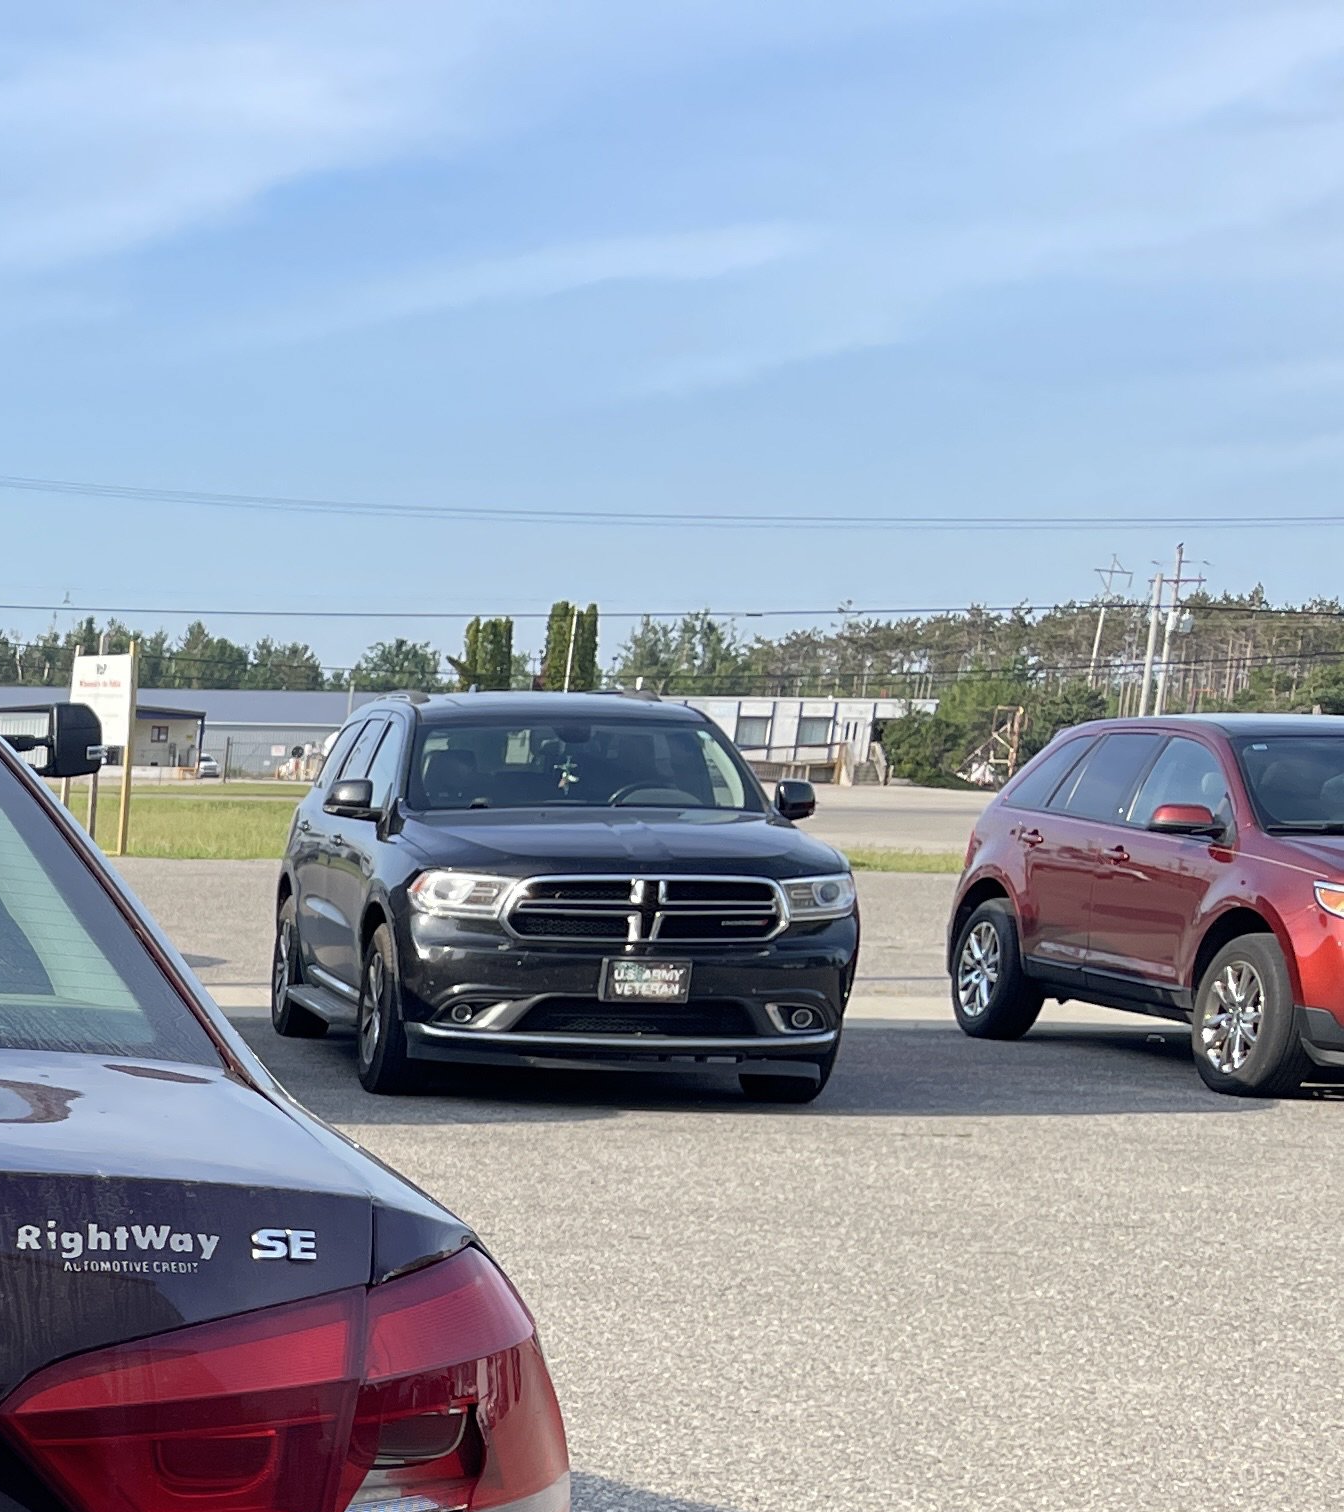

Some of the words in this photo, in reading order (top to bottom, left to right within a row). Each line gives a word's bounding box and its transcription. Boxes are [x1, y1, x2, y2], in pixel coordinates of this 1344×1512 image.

[642, 968, 681, 981] ARMY
[615, 983, 680, 996] VETERAN
[17, 1220, 219, 1259] RightWay
[251, 1228, 317, 1260] SE
[64, 1261, 149, 1273] AUTOMOTIVE
[153, 1261, 199, 1274] CREDIT
